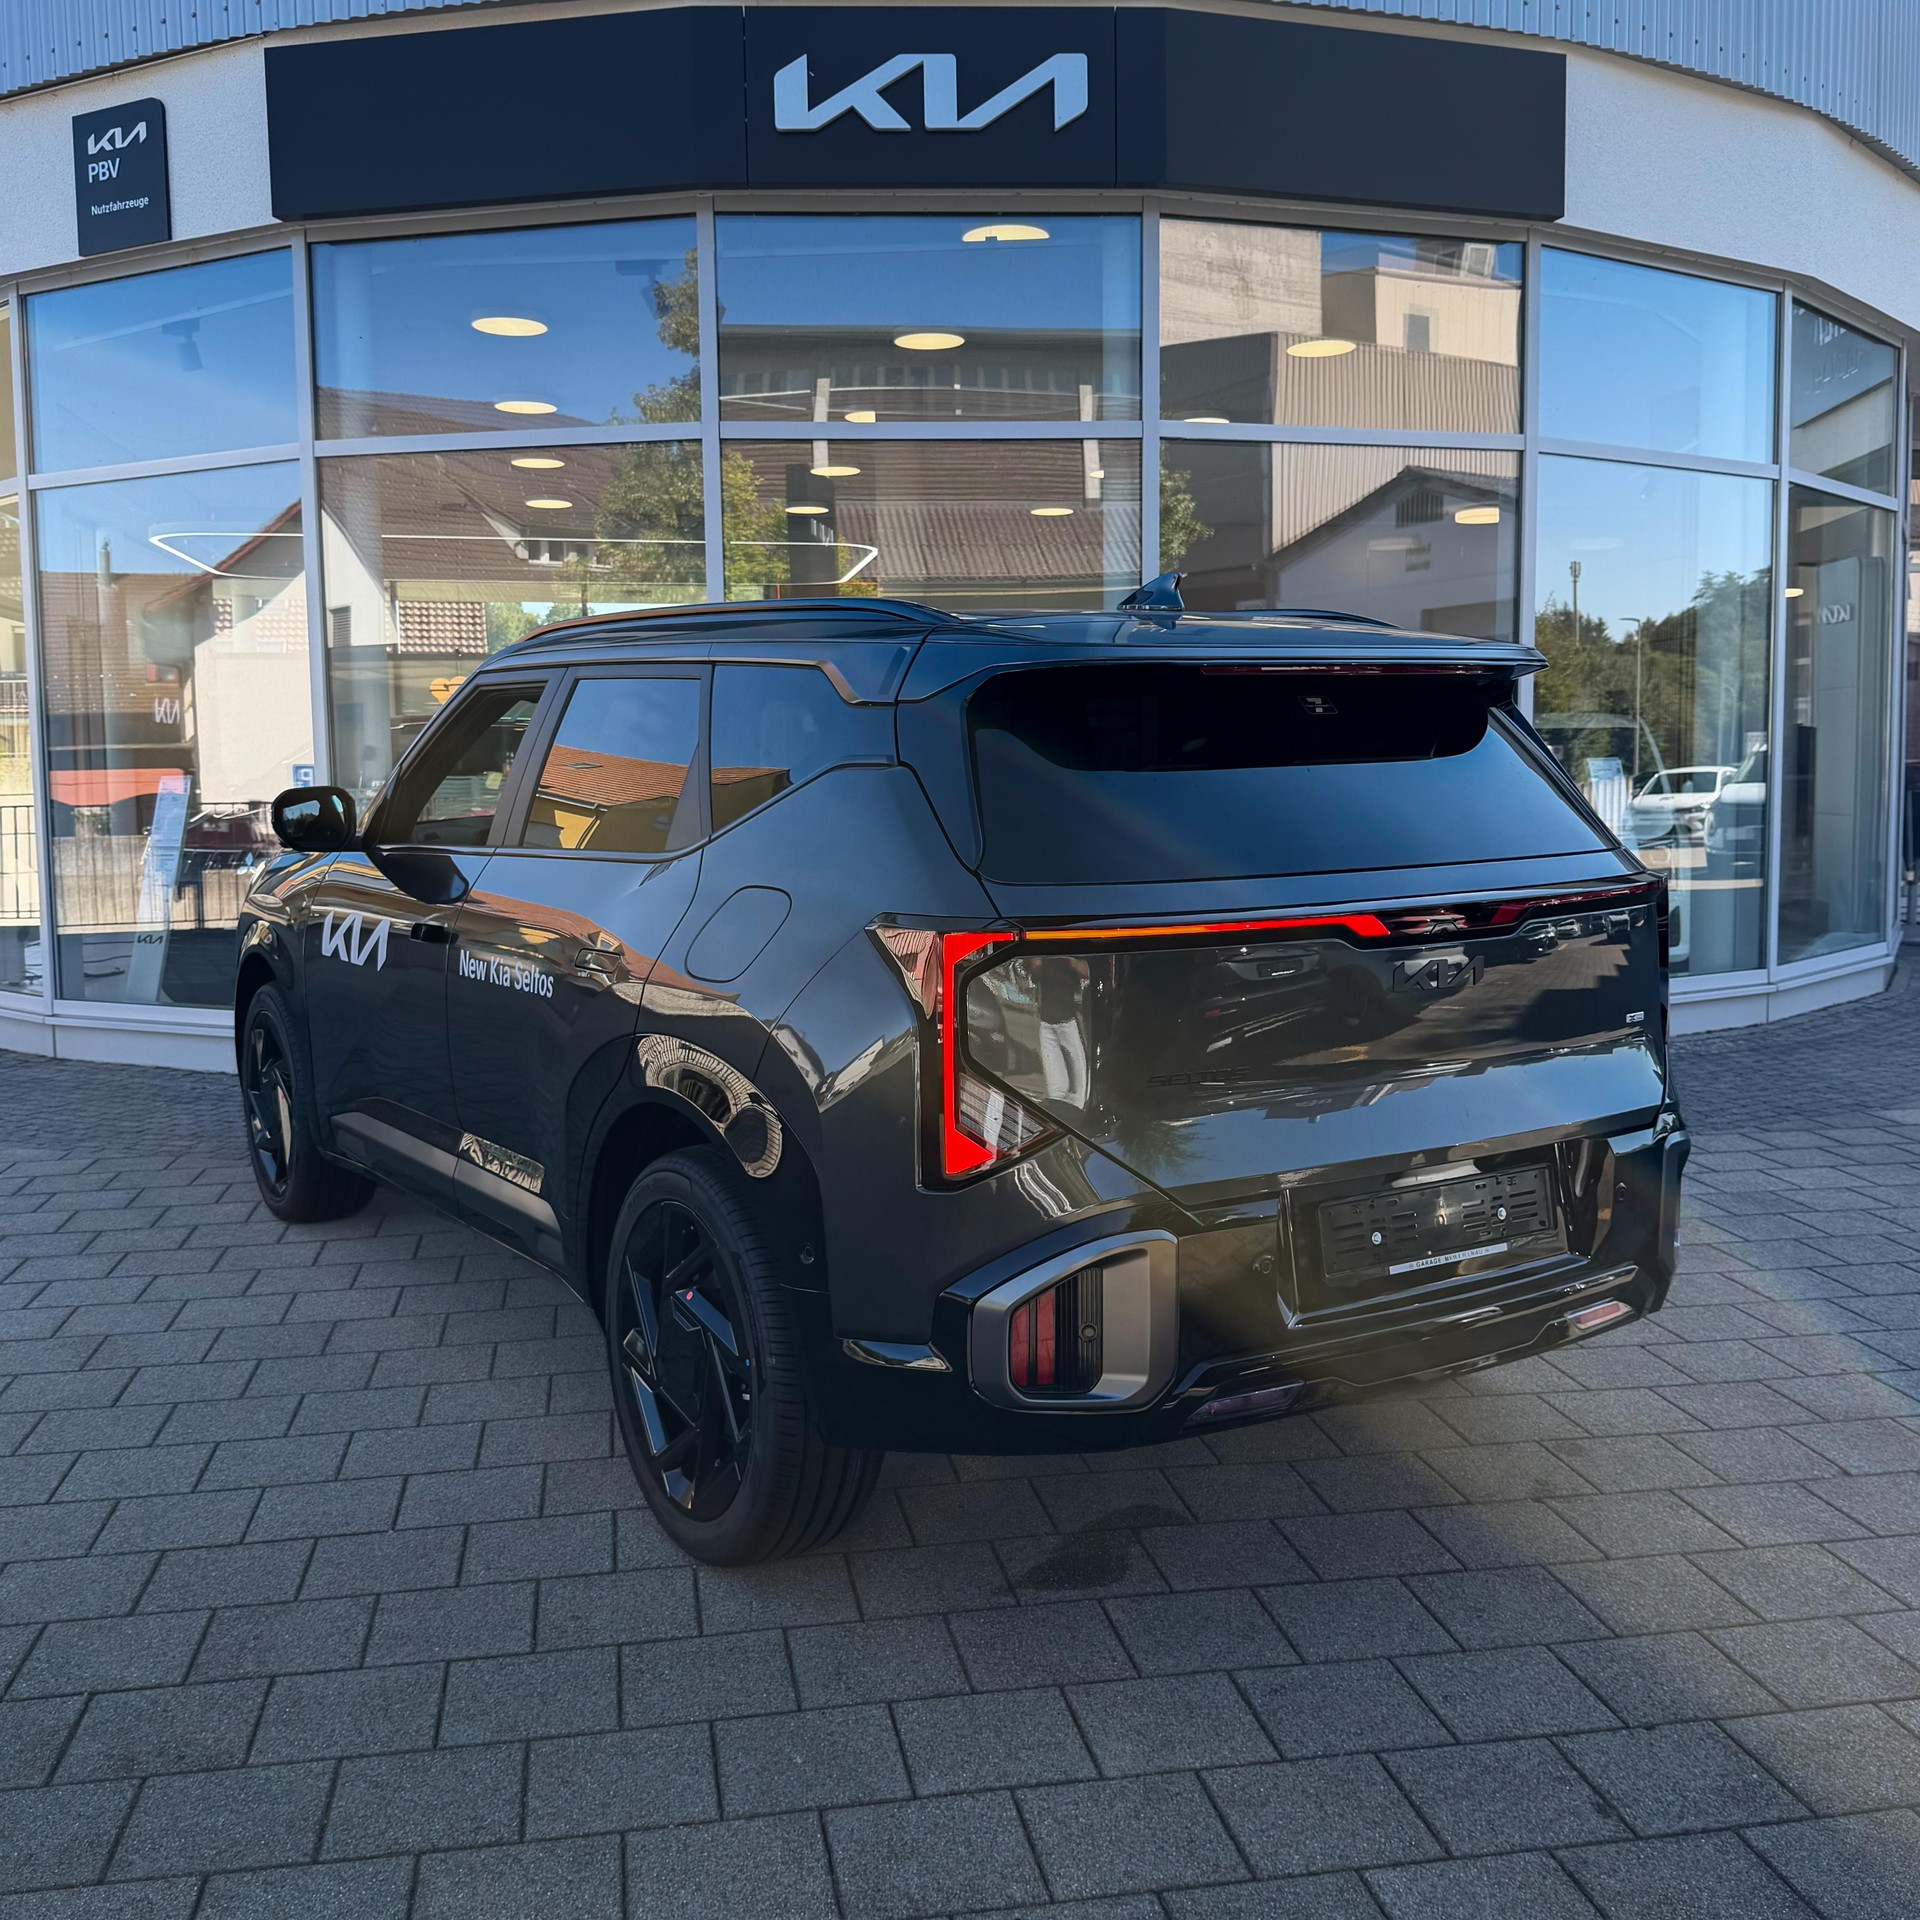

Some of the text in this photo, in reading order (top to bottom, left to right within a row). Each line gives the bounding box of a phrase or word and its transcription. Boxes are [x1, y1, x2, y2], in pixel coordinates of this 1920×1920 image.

[773, 53, 1088, 132] KIA
[87, 121, 147, 155] KIA
[88, 158, 120, 183] PBV
[91, 196, 149, 216] Nutzfahrzeuge
[137, 934, 163, 945] KIA
[321, 910, 391, 972] KIA
[459, 949, 555, 999] New Kia Seltos
[1392, 955, 1485, 993] KIA
